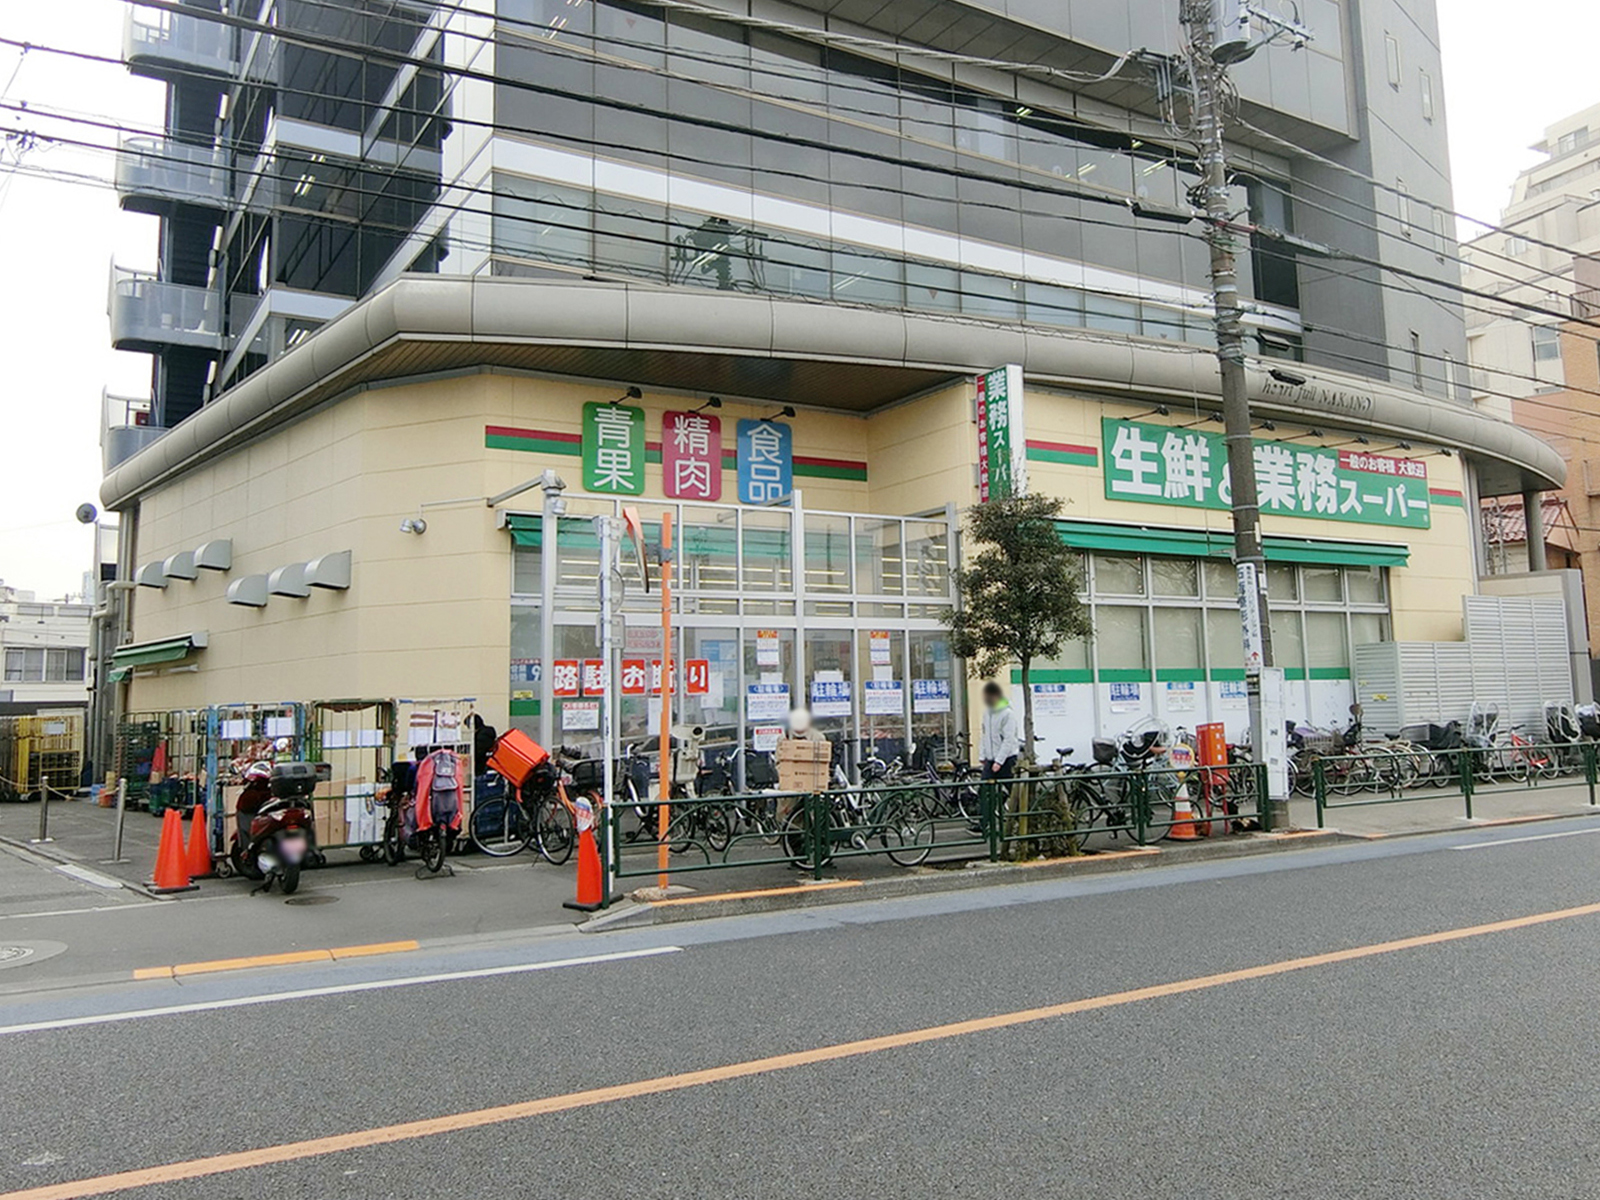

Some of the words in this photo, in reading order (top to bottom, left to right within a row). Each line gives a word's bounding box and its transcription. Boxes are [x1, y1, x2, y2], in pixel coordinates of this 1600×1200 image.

[1262, 378, 1293, 397] heart
[1294, 385, 1317, 403] full
[1318, 389, 1371, 412] NAKANO
[594, 407, 634, 490] 青果
[674, 415, 710, 497] 精肉
[747, 424, 783, 501] 食品
